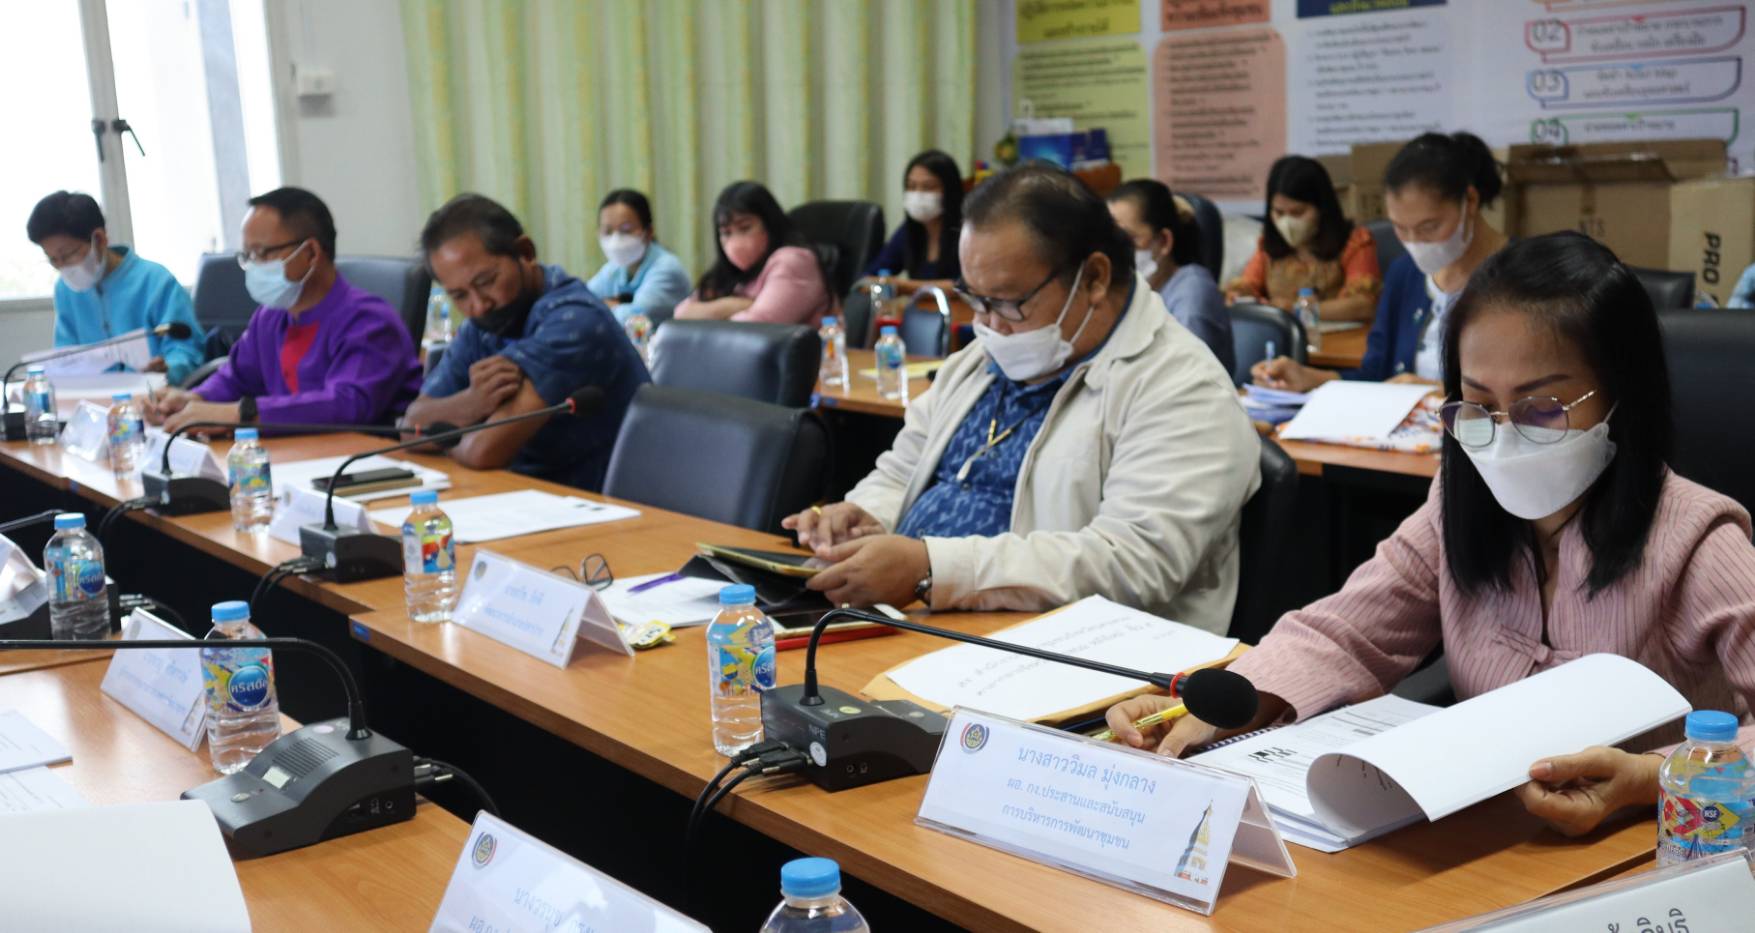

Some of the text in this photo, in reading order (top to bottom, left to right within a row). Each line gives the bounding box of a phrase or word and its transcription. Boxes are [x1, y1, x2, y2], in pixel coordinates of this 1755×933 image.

[1702, 231, 1721, 284] PRO
[1017, 746, 1157, 795] นางสาววิมล มุ่งกลาง
